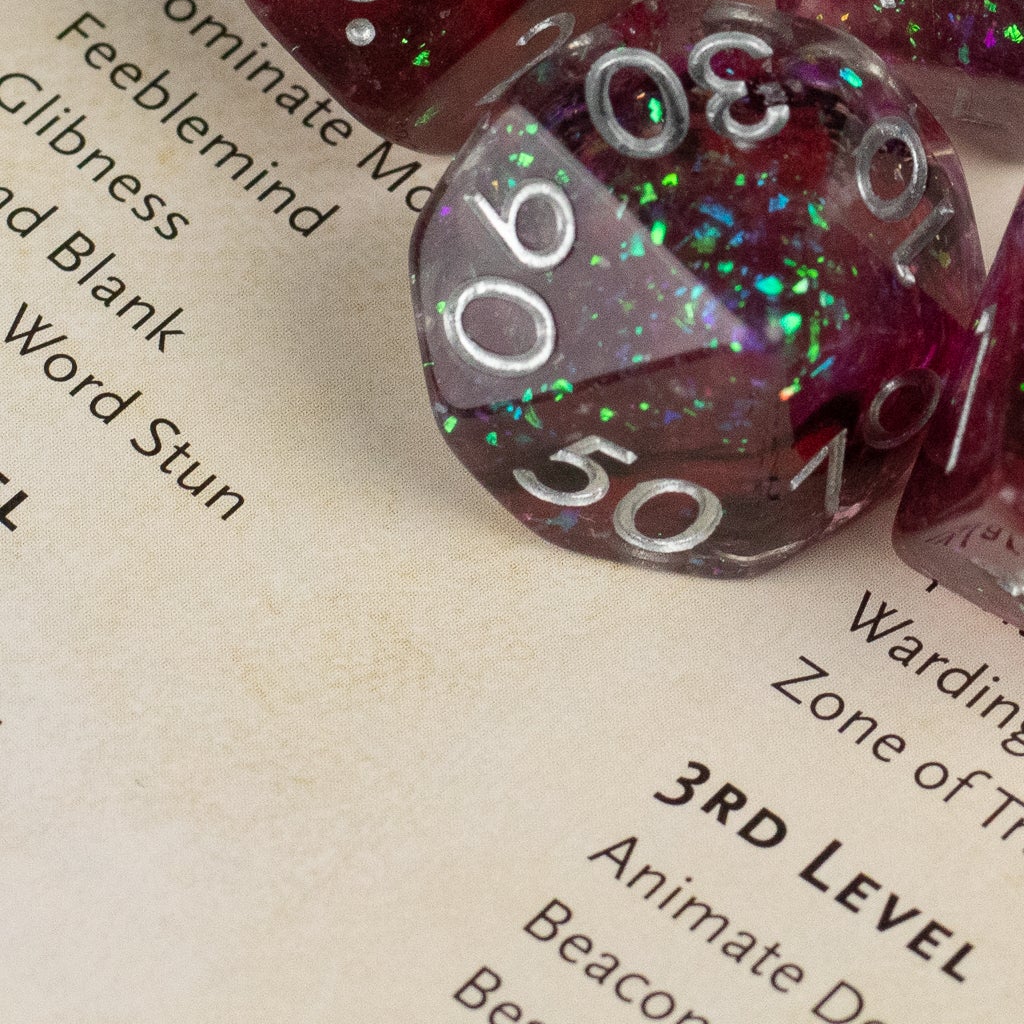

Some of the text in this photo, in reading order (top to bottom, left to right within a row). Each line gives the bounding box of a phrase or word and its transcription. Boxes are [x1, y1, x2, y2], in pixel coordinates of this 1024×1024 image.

[0, 71, 192, 242] Glibness
[56, 11, 341, 239] Feeblemind
[46, 229, 187, 354] Blank
[3, 301, 246, 522] Word Stun
[513, 434, 724, 554] 50
[770, 654, 909, 768] Zone
[913, 760, 994, 804] of
[587, 835, 805, 994] Animate
[652, 760, 980, 984] 3RD LEVEL
